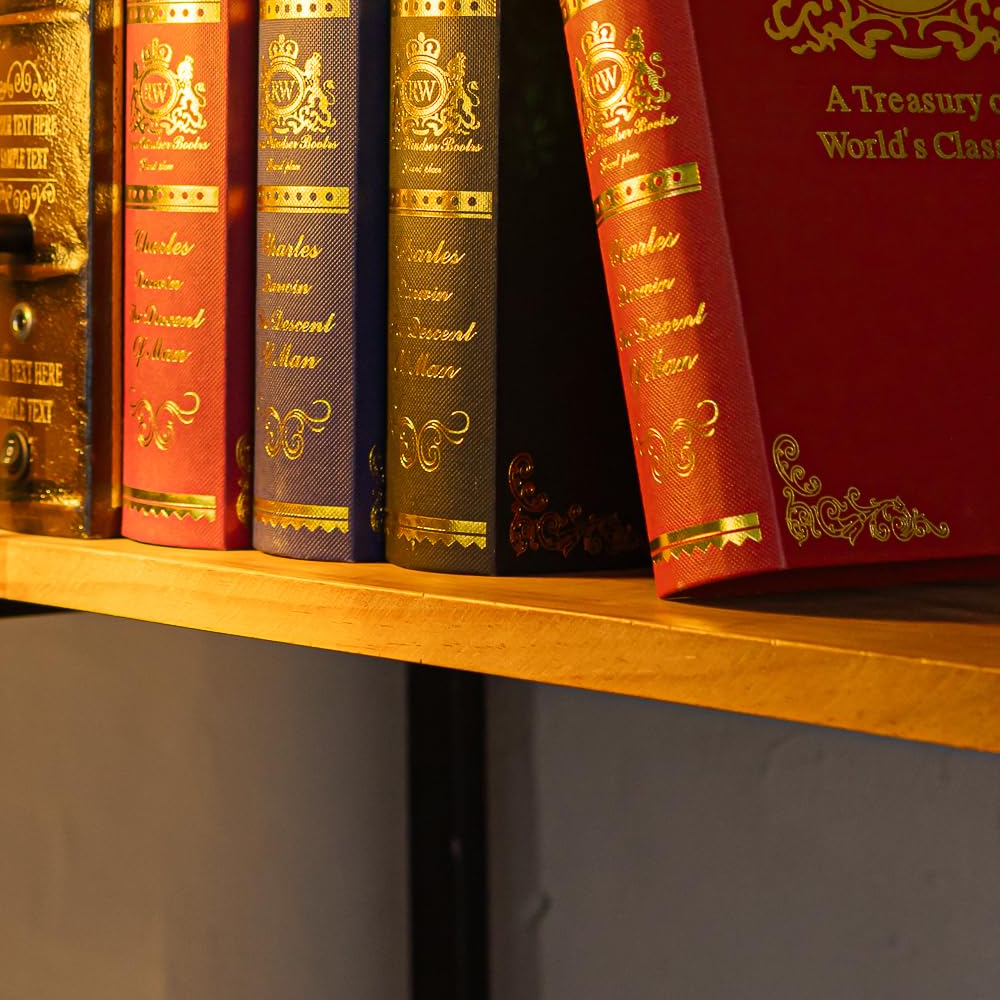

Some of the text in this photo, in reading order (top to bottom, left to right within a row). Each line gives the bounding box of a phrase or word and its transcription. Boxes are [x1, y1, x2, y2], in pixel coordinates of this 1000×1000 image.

[271, 80, 297, 103] RW
[407, 80, 437, 103] RW
[590, 64, 618, 97] RW
[825, 84, 852, 113] A
[851, 85, 983, 121] Treasury
[13, 114, 33, 136] TEXT
[33, 114, 57, 136] HERE
[816, 127, 928, 160] World's
[26, 147, 49, 170] TEXT
[10, 359, 32, 385] TEXT
[34, 361, 64, 387] HERE
[27, 398, 54, 424] TEXT
